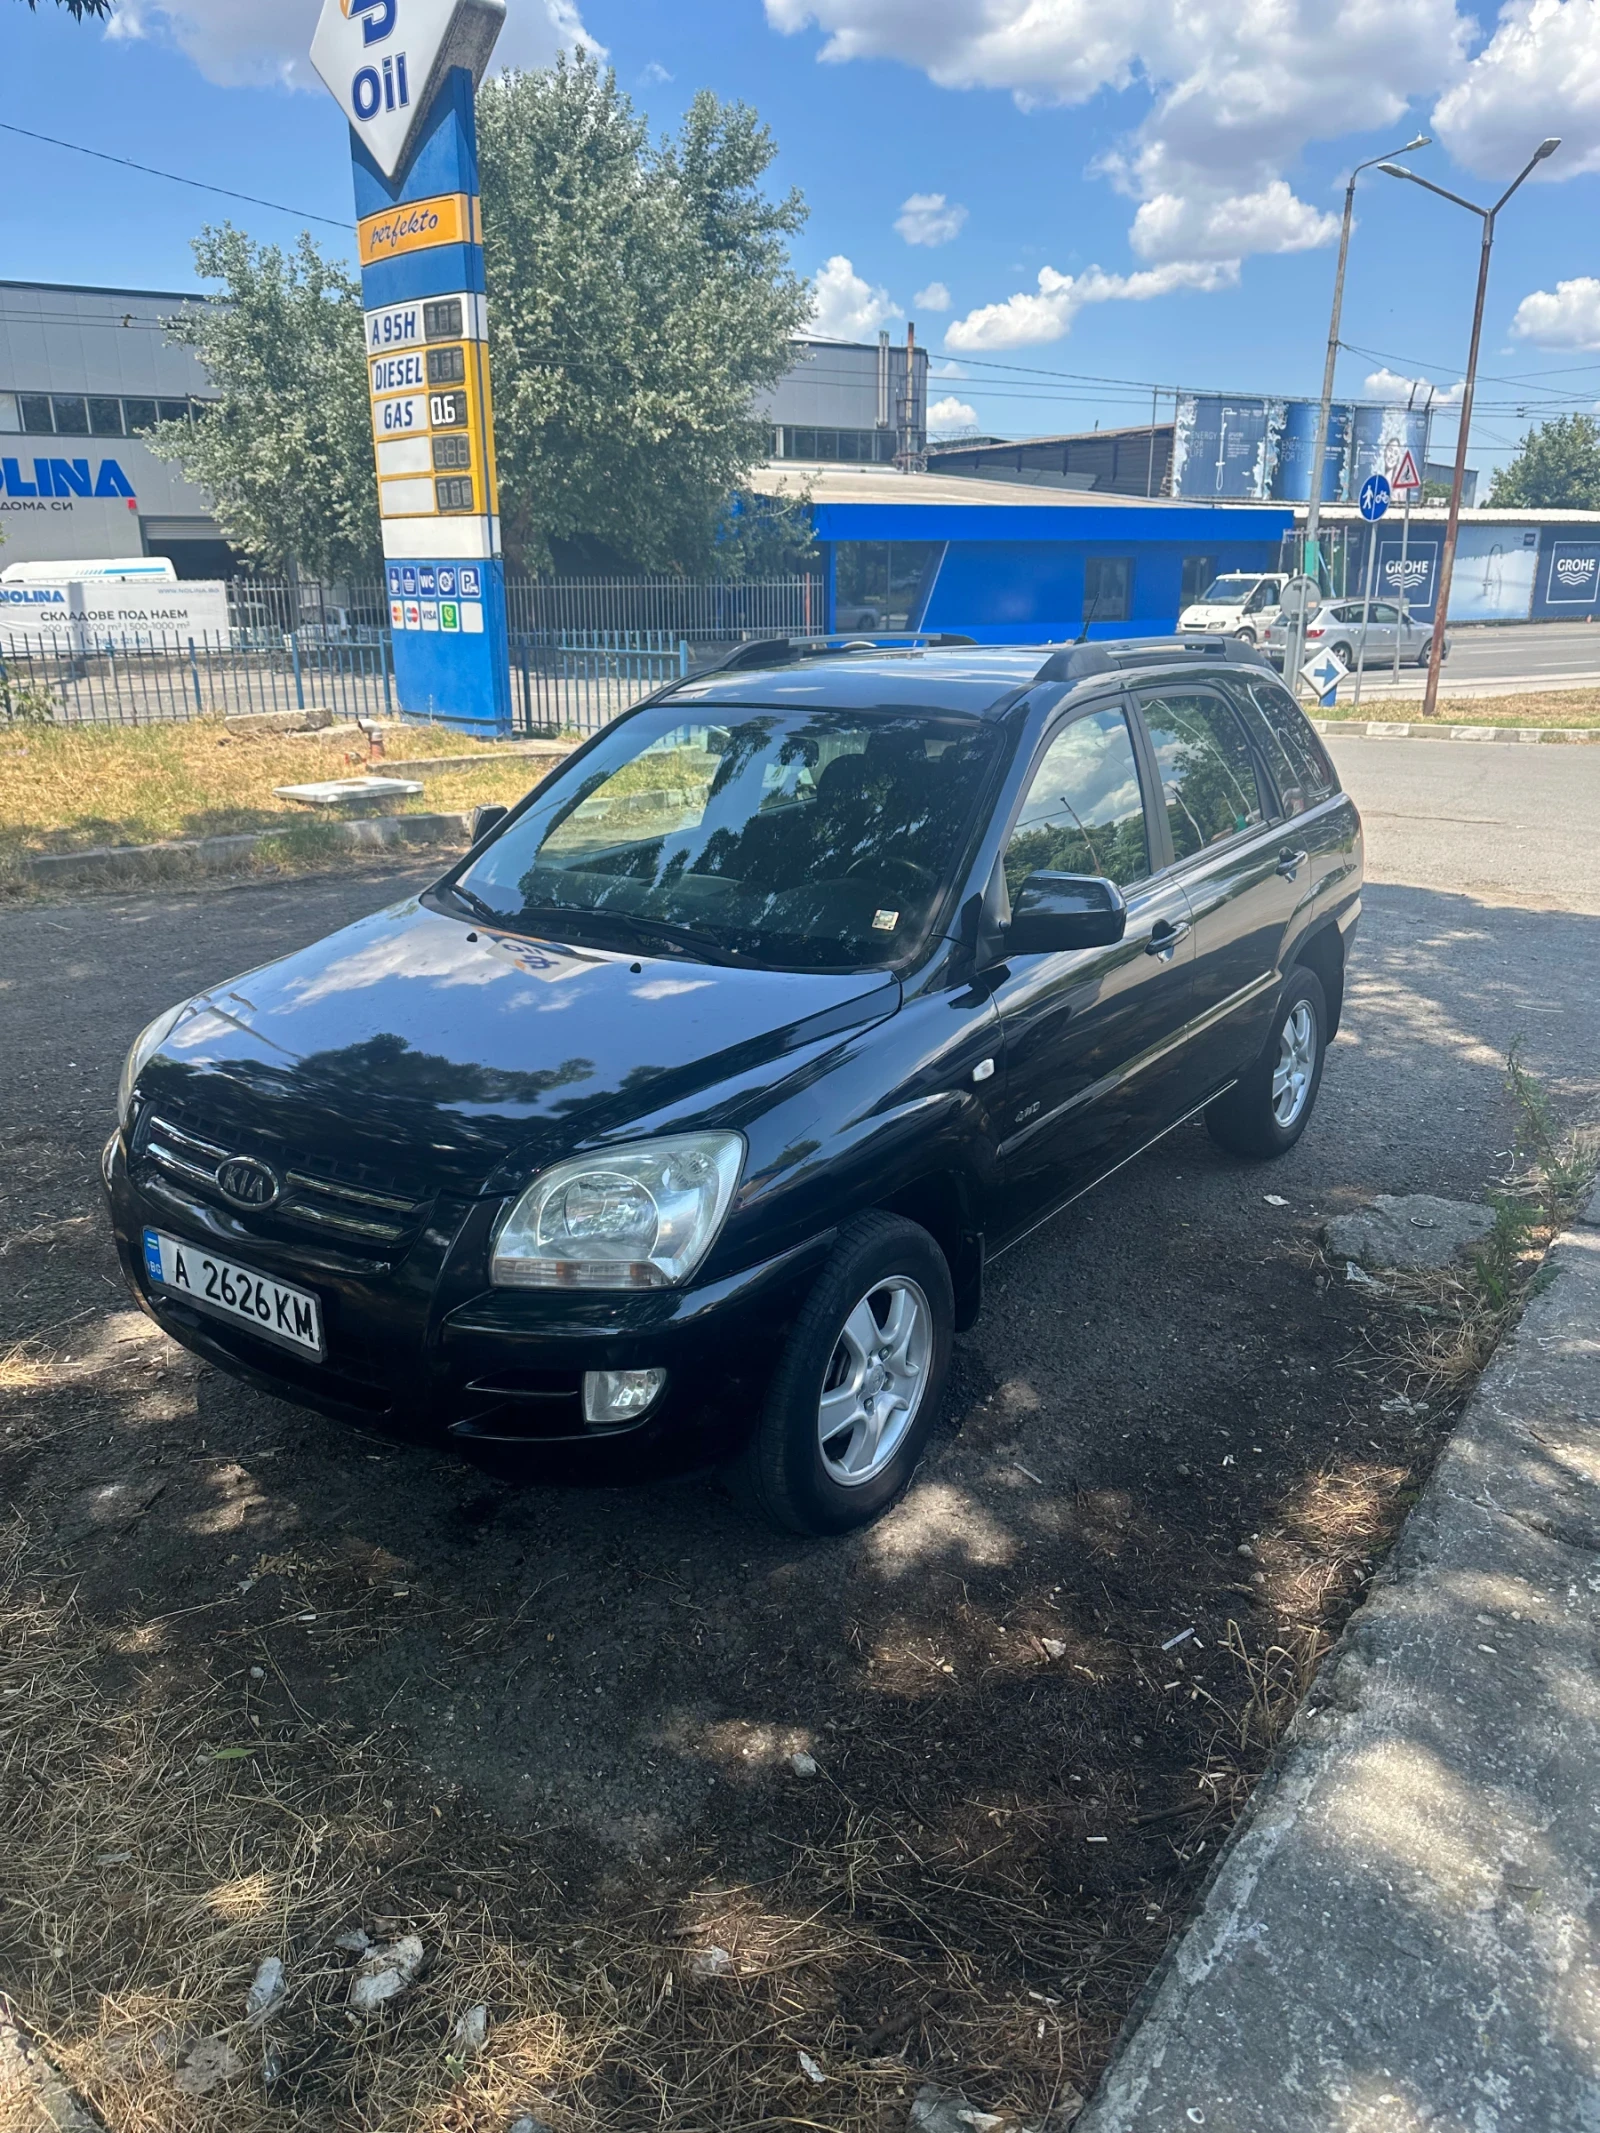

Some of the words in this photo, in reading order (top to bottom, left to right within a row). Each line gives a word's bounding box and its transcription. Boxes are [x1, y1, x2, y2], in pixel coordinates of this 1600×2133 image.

[352, 52, 409, 121] Oil
[371, 212, 438, 251] perfekto
[375, 357, 423, 391] DIESEL
[384, 401, 413, 429] GAS
[0, 458, 136, 497] LINA
[0, 502, 46, 511] ДОМА
[51, 502, 73, 511] СИ
[1386, 560, 1429, 573] GROHE
[1557, 559, 1596, 571] GROHE
[420, 574, 434, 588] WC
[40, 610, 115, 621] СКЛАДОВЕ
[118, 610, 148, 620] ПОД
[150, 609, 188, 619] НАЕМ
[422, 610, 437, 620] VISA
[42, 624, 62, 633] 200
[87, 622, 105, 632] 300
[223, 1165, 263, 1201] KIA
[150, 1261, 161, 1274] BG
